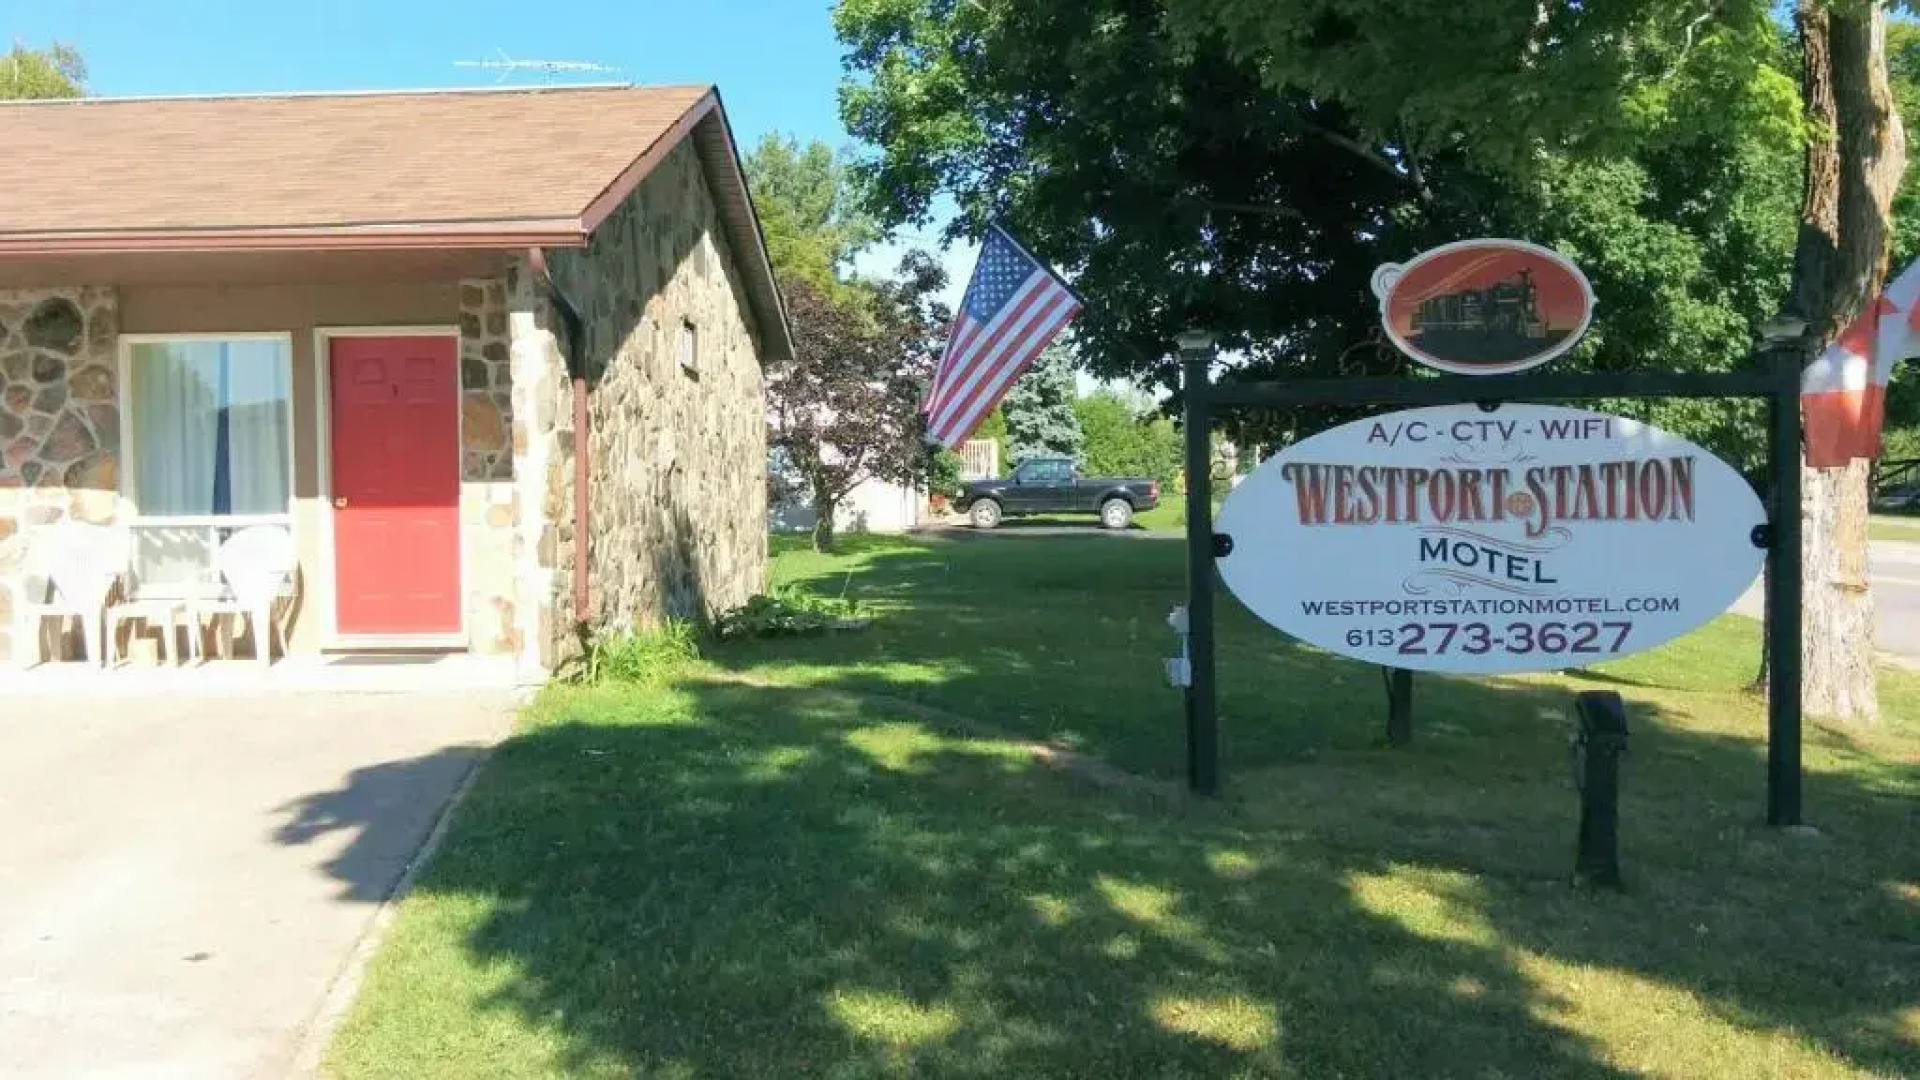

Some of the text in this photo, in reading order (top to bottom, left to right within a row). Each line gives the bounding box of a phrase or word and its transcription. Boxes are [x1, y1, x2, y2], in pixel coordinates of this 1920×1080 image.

[1367, 421, 1429, 447] A/C
[1450, 420, 1516, 442] CTV
[1539, 419, 1612, 440] WIFI
[1281, 455, 1696, 538] WESTPORT STATION
[1418, 537, 1558, 584] MOTEL
[1301, 597, 1680, 616] WESTPORTSTATIONMOTEL.COM
[1346, 621, 1633, 655] 613 273-3627
